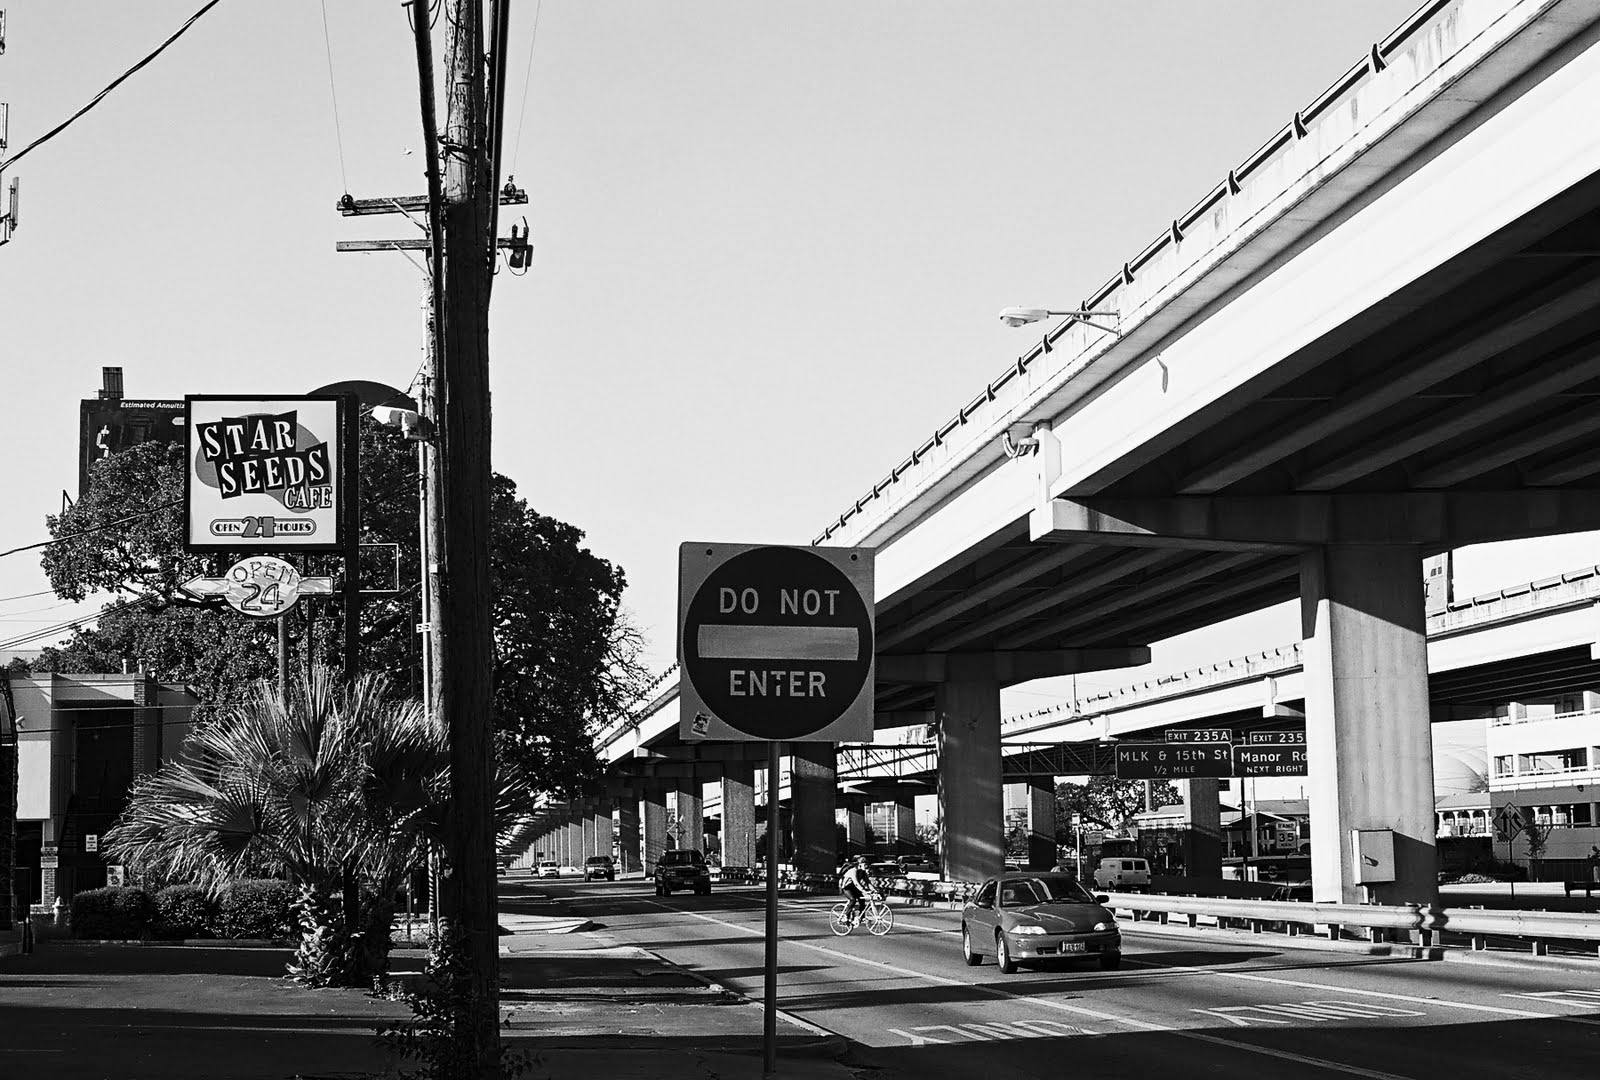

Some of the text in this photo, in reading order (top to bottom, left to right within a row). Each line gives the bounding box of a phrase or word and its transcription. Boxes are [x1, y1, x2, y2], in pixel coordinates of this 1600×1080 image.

[120, 401, 156, 409] Estimated
[203, 418, 295, 459] STAR
[220, 449, 325, 495] SEEDS
[283, 485, 333, 510] CAFE
[215, 515, 311, 538] OPEN 24 HOURS
[232, 561, 294, 585] OPEN
[240, 582, 284, 611] 24
[719, 587, 841, 616] DO NOT
[729, 669, 827, 697] ENTER
[1167, 731, 1229, 741] EXIT 235A
[1253, 733, 1304, 743] EXIT 235
[1120, 749, 1228, 762] MLK & 15th St
[1241, 752, 1281, 763] Manor
[1246, 764, 1304, 774] NEXT RIGHT
[1279, 832, 1294, 842] 35
